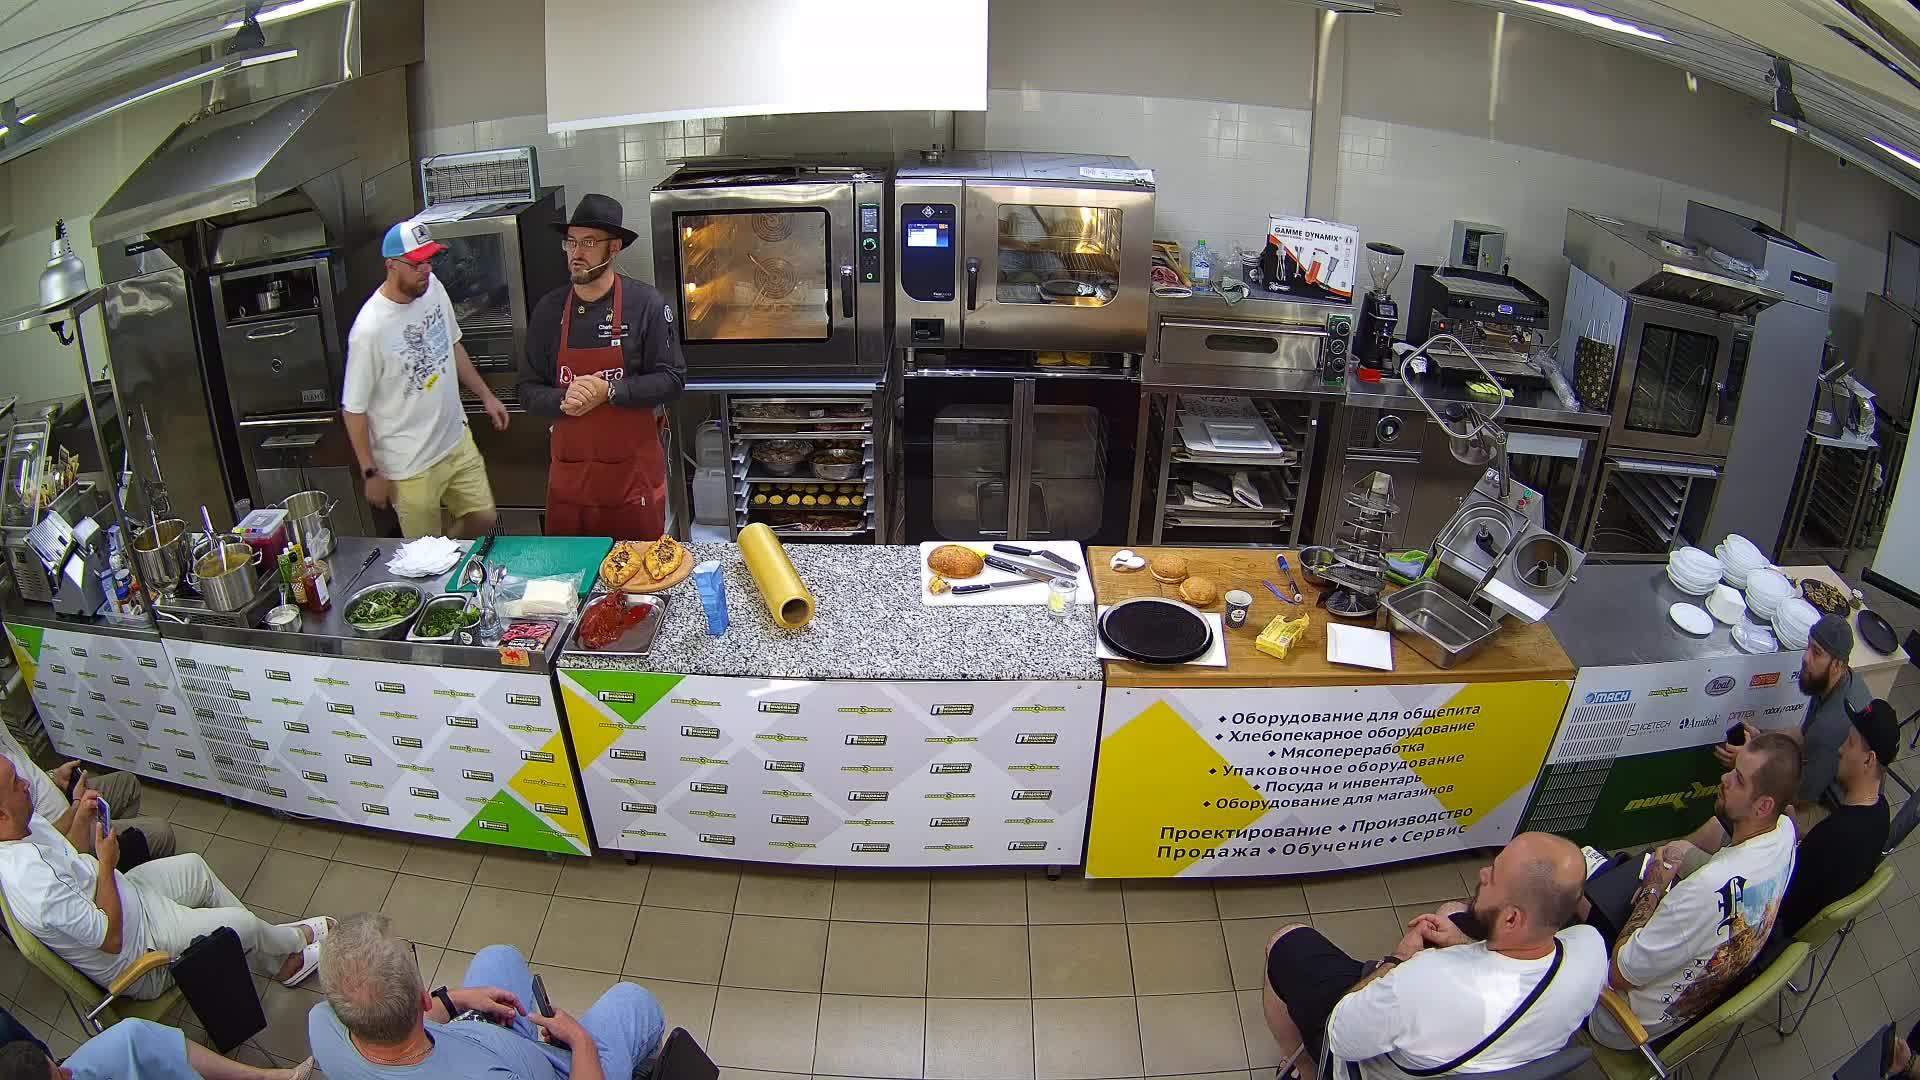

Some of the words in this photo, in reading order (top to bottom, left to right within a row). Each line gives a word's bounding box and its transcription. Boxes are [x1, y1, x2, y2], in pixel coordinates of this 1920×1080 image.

[1274, 226, 1302, 237] GAMME
[1595, 691, 1629, 703] MACH
[1232, 712, 1363, 727] Оборудование
[1366, 711, 1399, 723] для
[1403, 706, 1480, 720] общепита
[1229, 730, 1363, 743] Хлебопекарное
[1368, 721, 1475, 740] оборудование
[1281, 743, 1425, 759] Мясопереработка
[1223, 765, 1342, 777] Упаковочное
[1347, 753, 1465, 773] оборудование
[1266, 781, 1323, 794] Посуда
[1328, 782, 1338, 790] и
[1343, 774, 1422, 789] инвентарь
[1216, 797, 1340, 811] Оборудование
[1343, 795, 1373, 807] для
[1377, 783, 1454, 803] магазинов
[1160, 825, 1332, 842] Проектирование
[1352, 808, 1473, 834] Производство
[1157, 846, 1261, 861] Продажа
[1282, 837, 1384, 857] Обучение
[1402, 825, 1468, 843] Сервис
